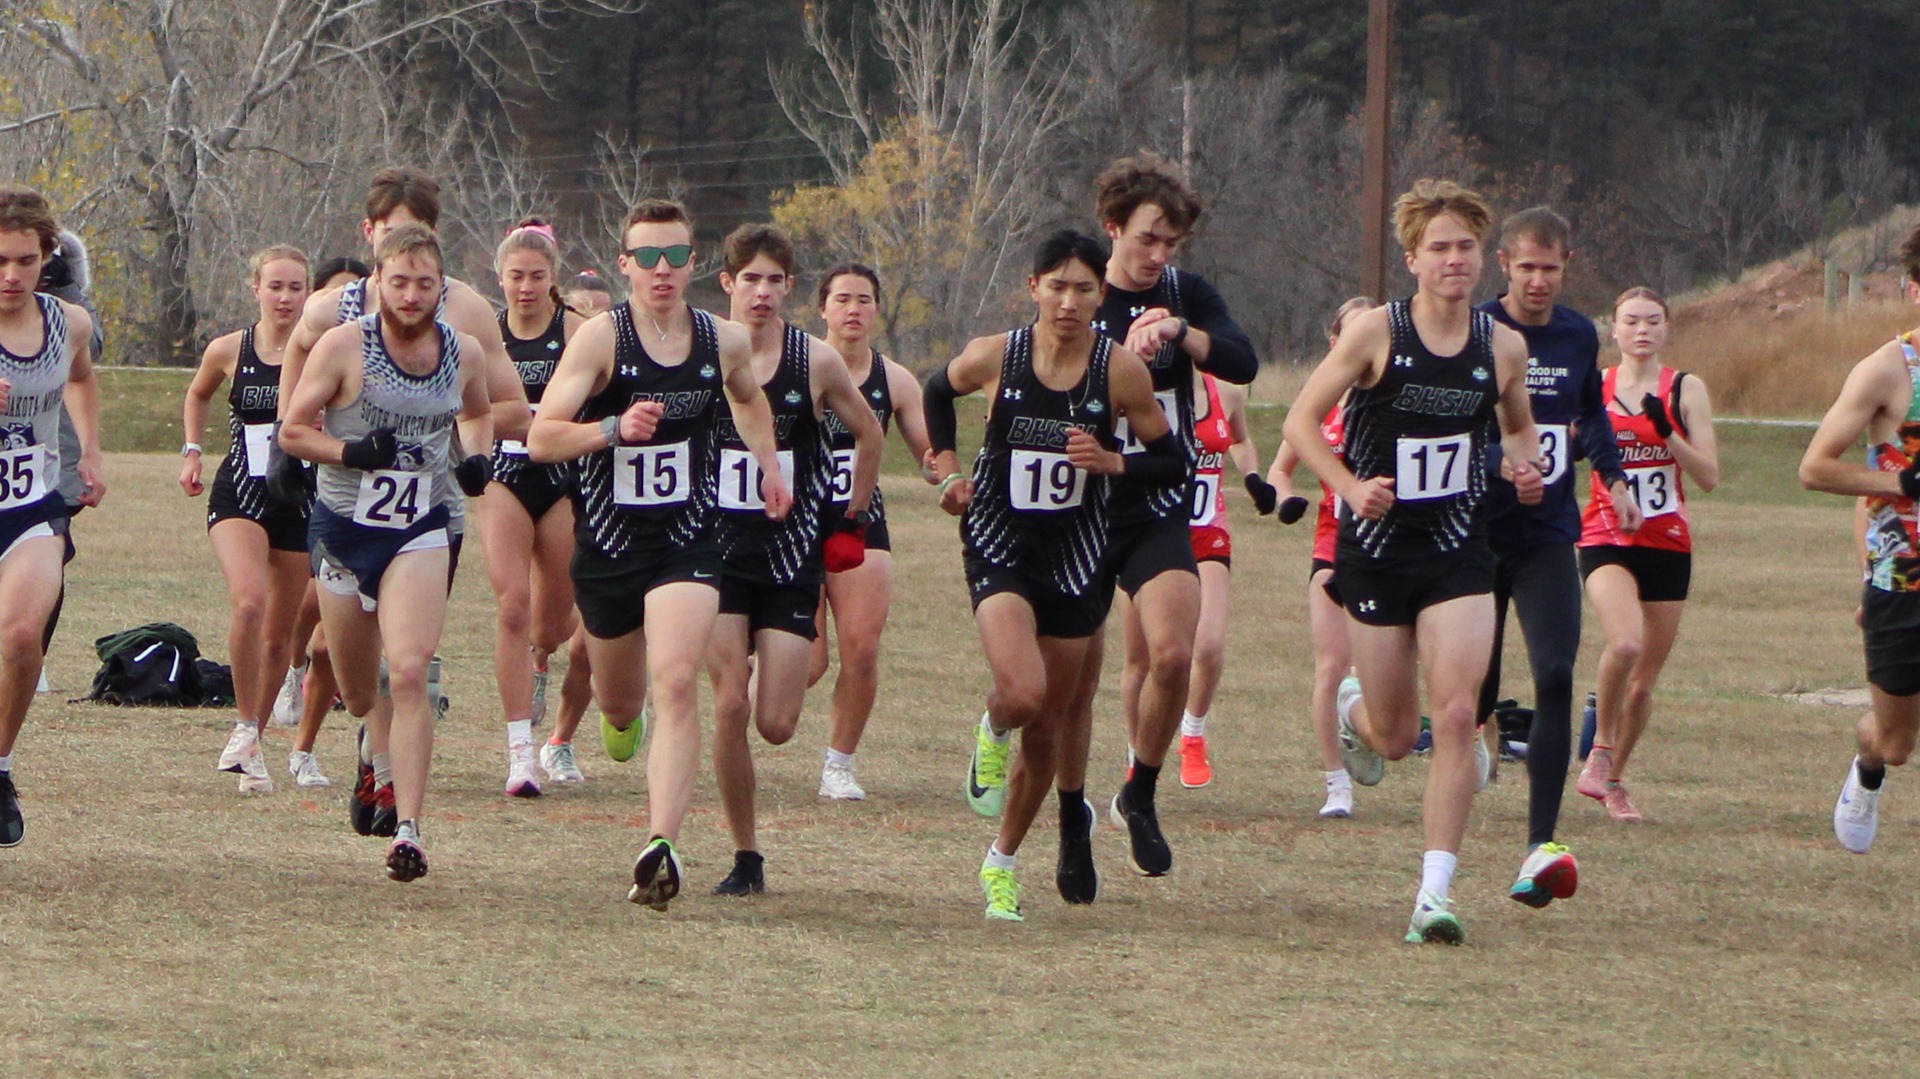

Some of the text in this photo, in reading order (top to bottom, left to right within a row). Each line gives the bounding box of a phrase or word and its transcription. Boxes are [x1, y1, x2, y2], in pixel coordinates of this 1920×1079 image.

[360, 399, 390, 431] SOUTH
[1392, 383, 1483, 416] BHSU
[627, 451, 677, 497] 15
[1025, 458, 1076, 504] 19
[1411, 442, 1459, 492] 17
[366, 476, 418, 523] 24
